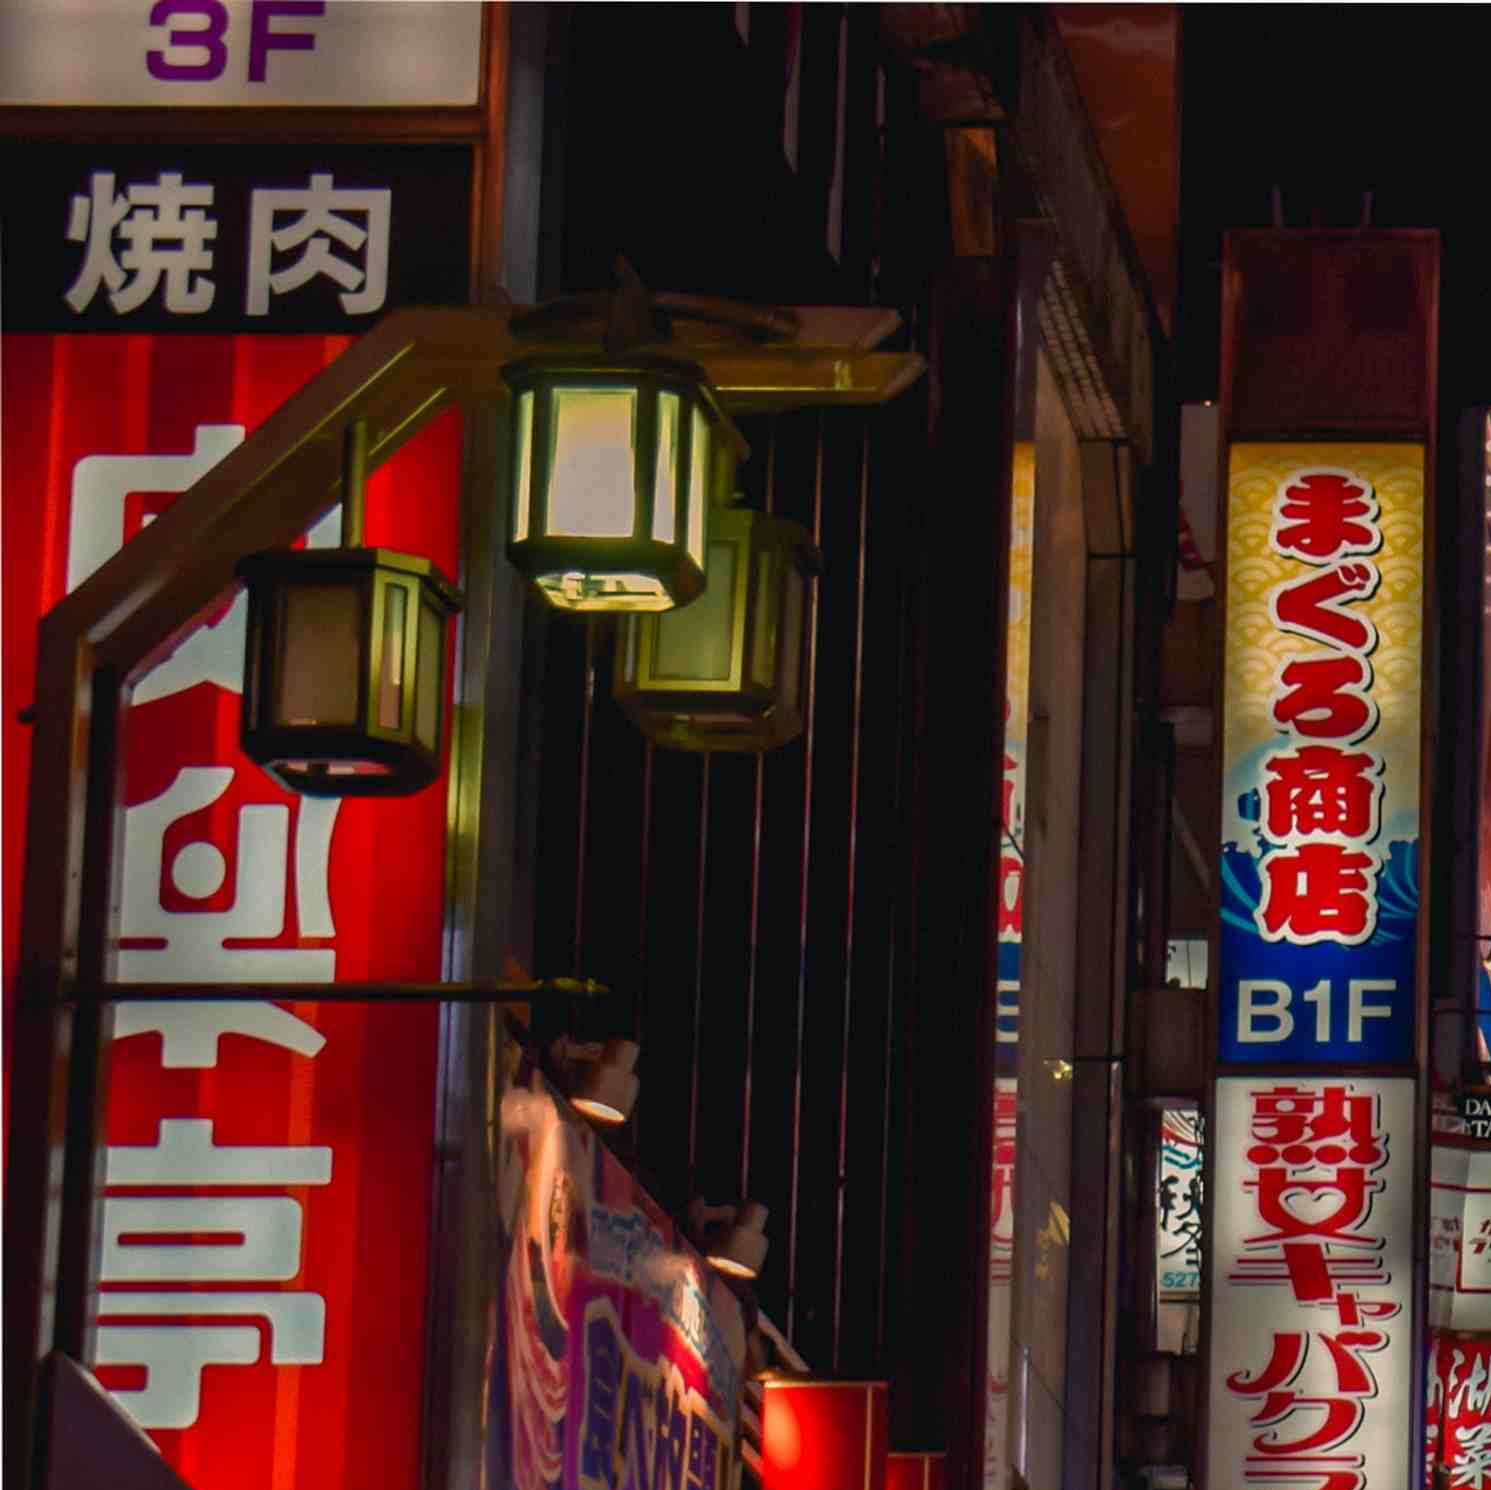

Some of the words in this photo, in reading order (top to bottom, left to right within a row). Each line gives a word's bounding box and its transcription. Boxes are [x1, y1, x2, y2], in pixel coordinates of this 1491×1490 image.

[145, 0, 326, 83] 3F
[65, 171, 393, 316] 焼肉
[1259, 467, 1382, 945] まぐろ商店
[1235, 977, 1398, 1044] B1F
